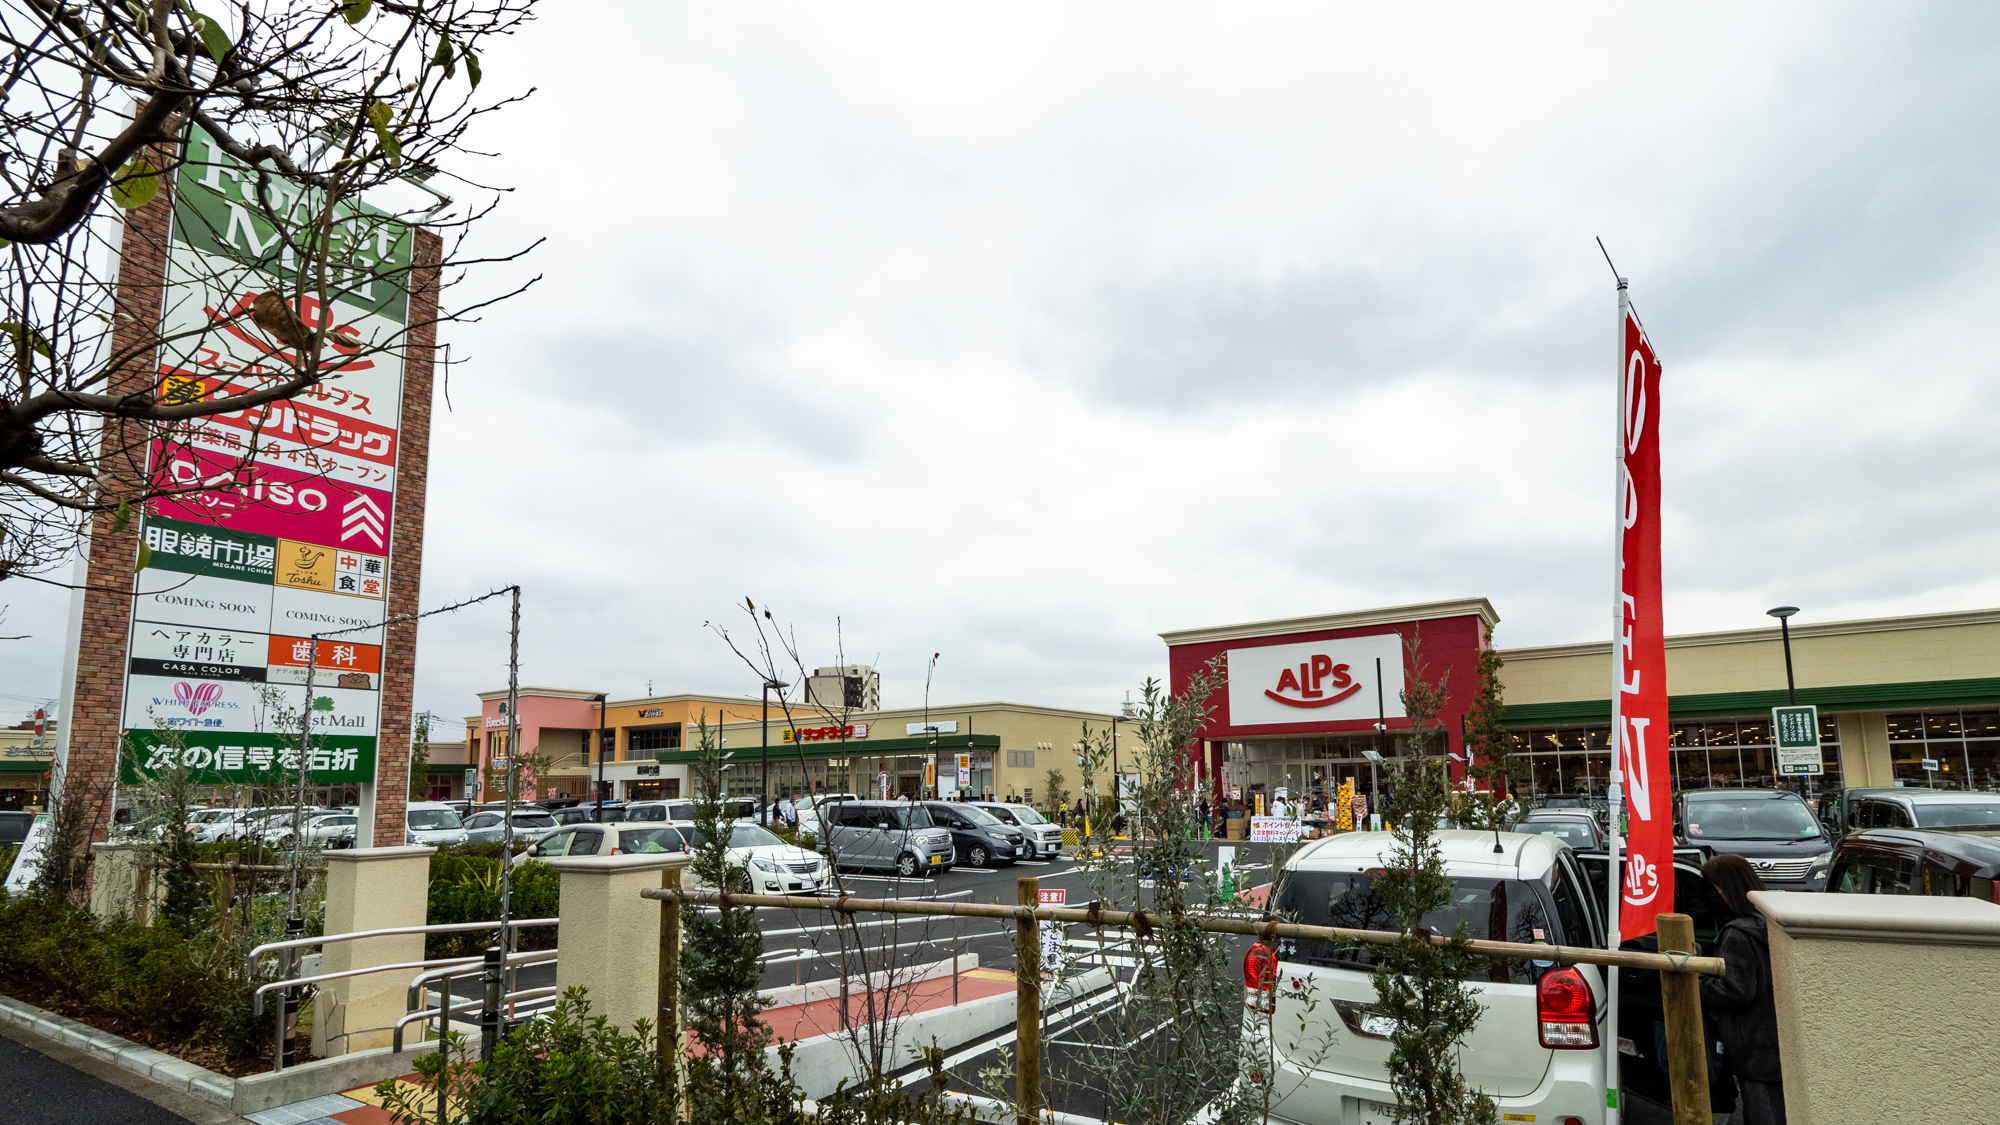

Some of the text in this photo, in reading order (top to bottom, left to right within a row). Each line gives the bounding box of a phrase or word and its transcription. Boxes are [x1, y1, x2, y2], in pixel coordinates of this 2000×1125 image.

[195, 346, 373, 415] スーパールプス
[170, 459, 327, 512] DAISO
[145, 526, 275, 569] 眼鏡市場
[212, 561, 273, 575] MEGANE ICHIBA
[286, 573, 321, 586] Toshu
[155, 593, 256, 614] COMING SOON
[286, 610, 371, 627] COMING SOON
[151, 629, 254, 647] ヘアカラー
[171, 644, 236, 663] 専門店
[162, 662, 241, 675] CASA COLOR
[275, 667, 333, 678] テディ歯科ニック
[1276, 654, 1352, 698] ALPS
[152, 697, 189, 706] WHITE
[328, 714, 365, 728] Mall
[144, 744, 359, 771] 次の信号を右折
[1626, 853, 1658, 896] LPS
[1040, 892, 1062, 902] 注意!
